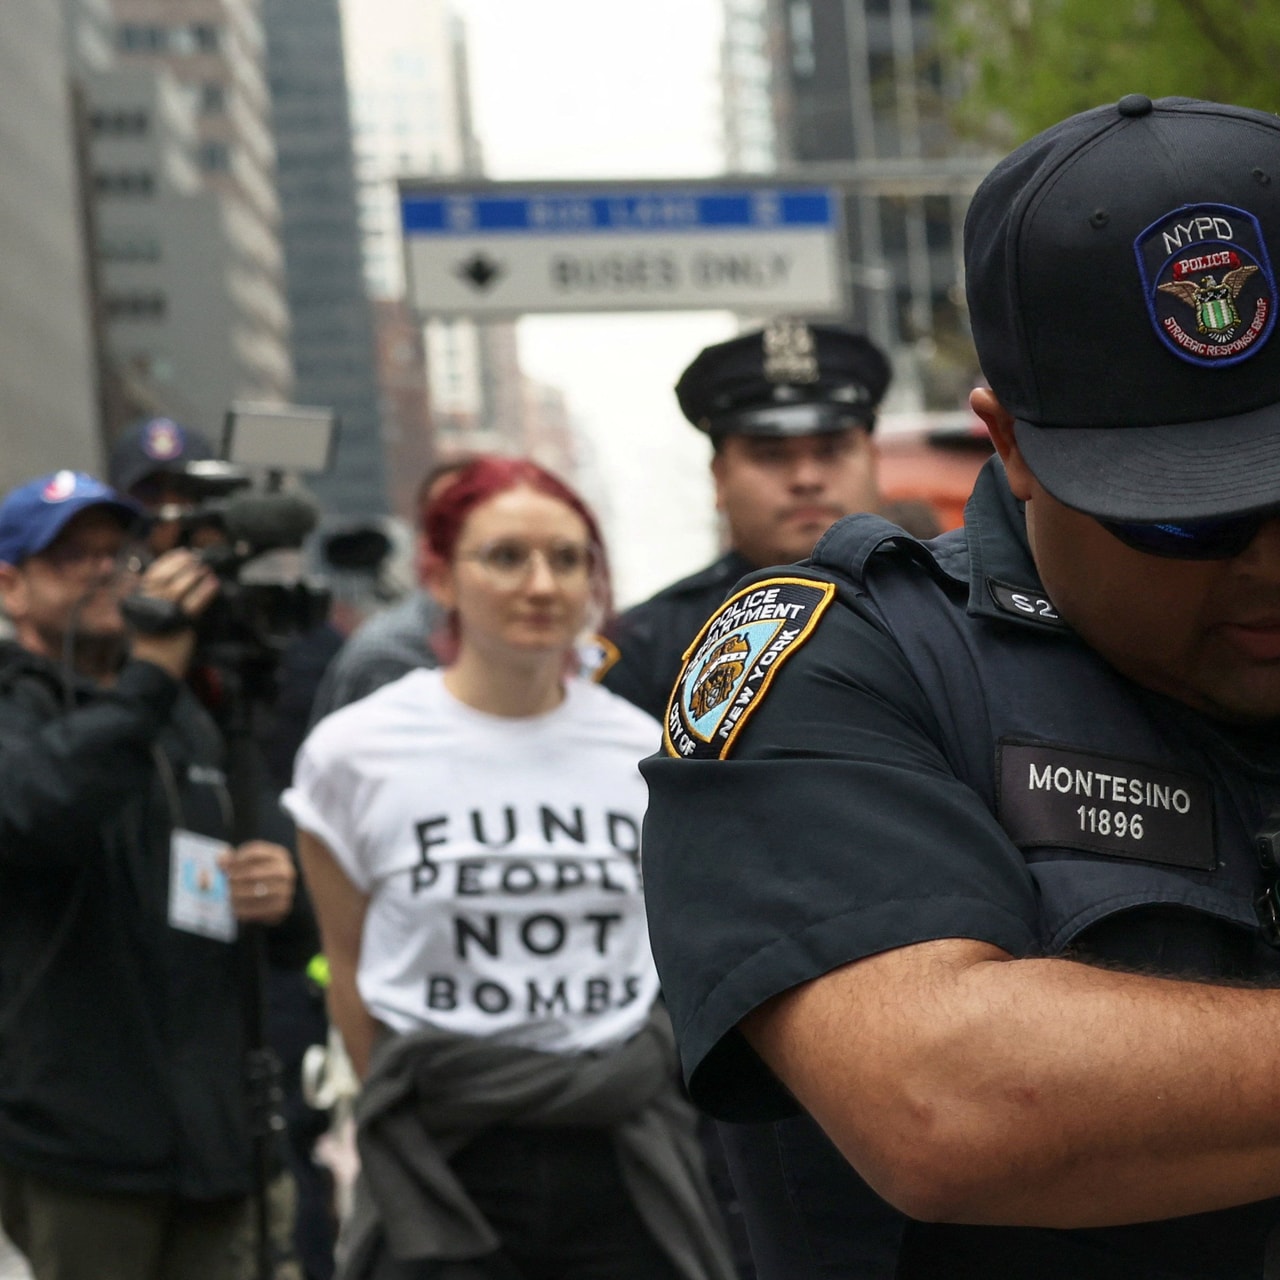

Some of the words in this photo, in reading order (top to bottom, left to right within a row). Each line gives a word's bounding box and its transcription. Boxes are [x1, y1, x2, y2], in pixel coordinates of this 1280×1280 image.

[1162, 217, 1233, 254] NYPD
[551, 253, 681, 293] BUSES
[691, 250, 792, 289] ONLY
[1179, 251, 1231, 274] POLICE
[1164, 316, 1207, 354] STRATEGIC
[1206, 328, 1256, 356] RESPONSE
[1251, 297, 1269, 335] GROUP
[707, 588, 780, 637] POLICE
[1011, 594, 1058, 618] S2
[719, 686, 755, 739] NEW
[748, 628, 801, 682] YORK
[669, 702, 684, 740] CITY
[679, 733, 697, 757] OF
[1028, 763, 1191, 814] MONTESINO
[413, 804, 641, 858] FUND
[1076, 804, 1144, 840] 11896
[410, 858, 644, 897] PEOPL
[453, 912, 624, 960] NOT
[426, 973, 643, 1017] BOMBS
